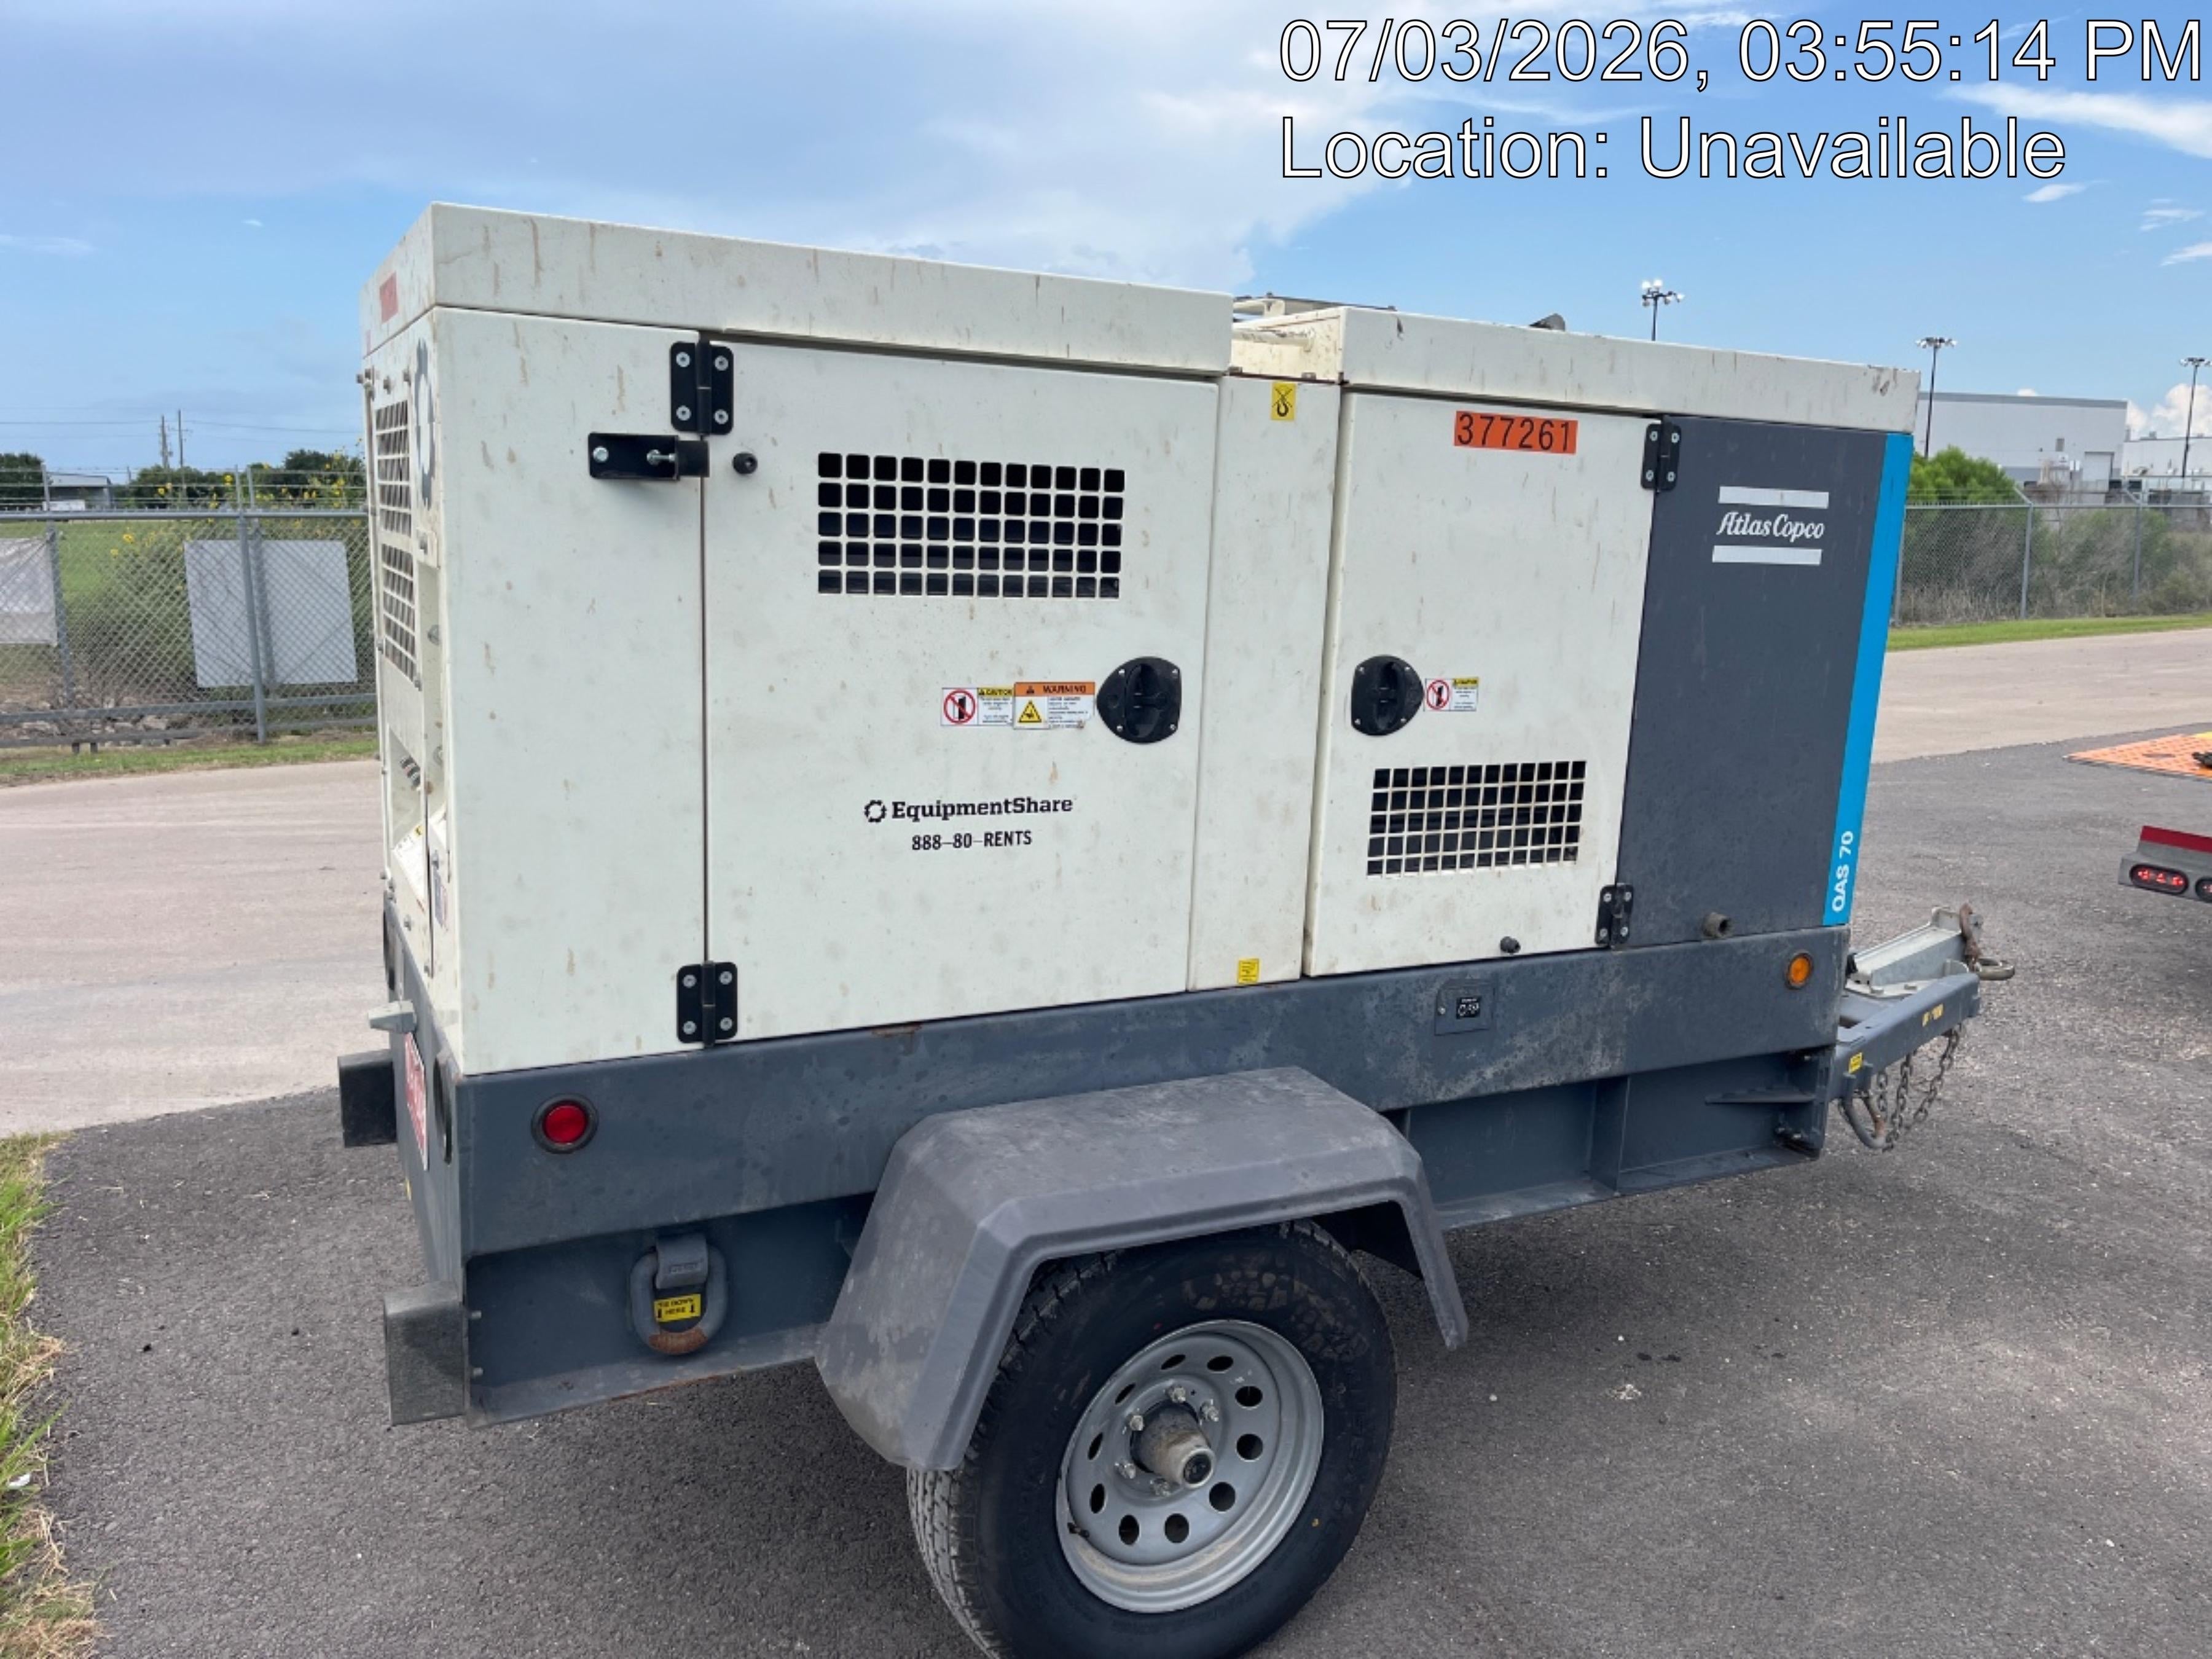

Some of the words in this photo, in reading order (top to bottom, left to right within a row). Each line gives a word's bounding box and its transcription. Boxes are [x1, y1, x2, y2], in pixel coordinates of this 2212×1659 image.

[1457, 412, 1569, 452] 377261
[1716, 511, 1772, 536] Atlas
[1773, 513, 1826, 543] Copco
[1043, 685, 1087, 694] WARNING
[891, 796, 1073, 822] EquipmentShare
[1839, 831, 1854, 859] 70
